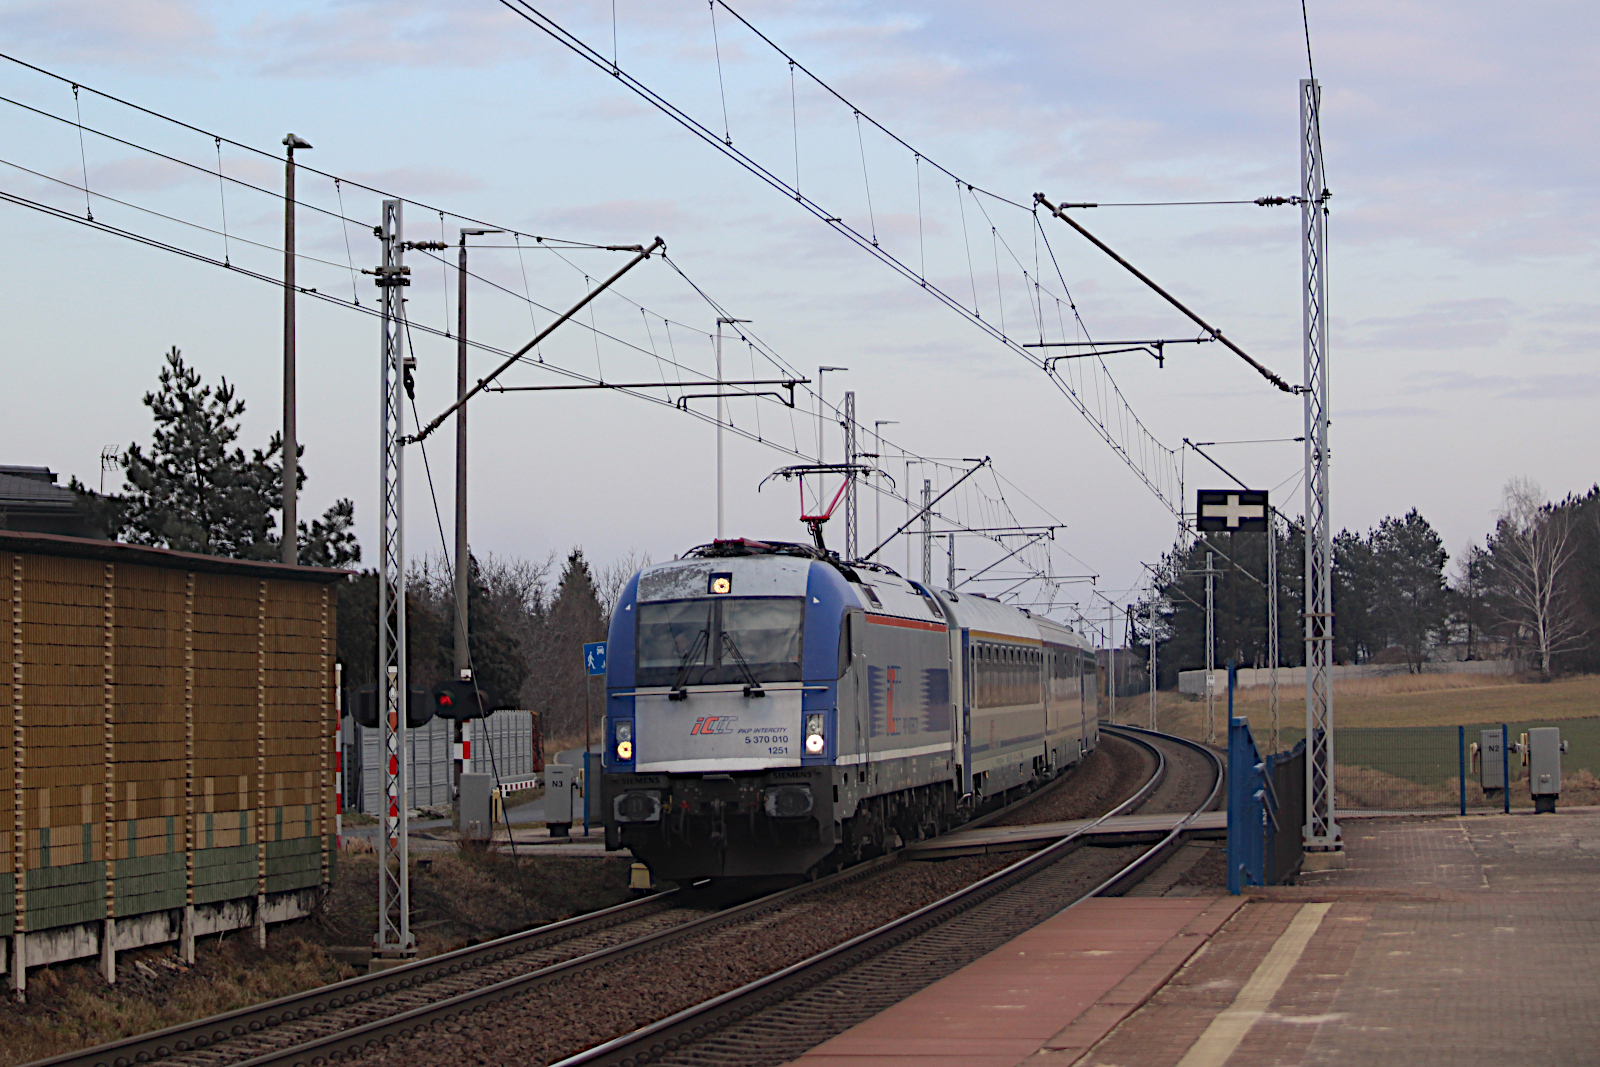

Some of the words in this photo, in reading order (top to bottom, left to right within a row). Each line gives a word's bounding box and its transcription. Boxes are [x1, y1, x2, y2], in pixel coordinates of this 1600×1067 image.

[745, 736, 751, 744] 5
[753, 735, 770, 744] 370
[772, 735, 789, 743] 010
[768, 746, 788, 754] 1251
[773, 771, 812, 779] SIEMENS
[552, 780, 563, 788] N3
[622, 776, 660, 785] SIEMENS
